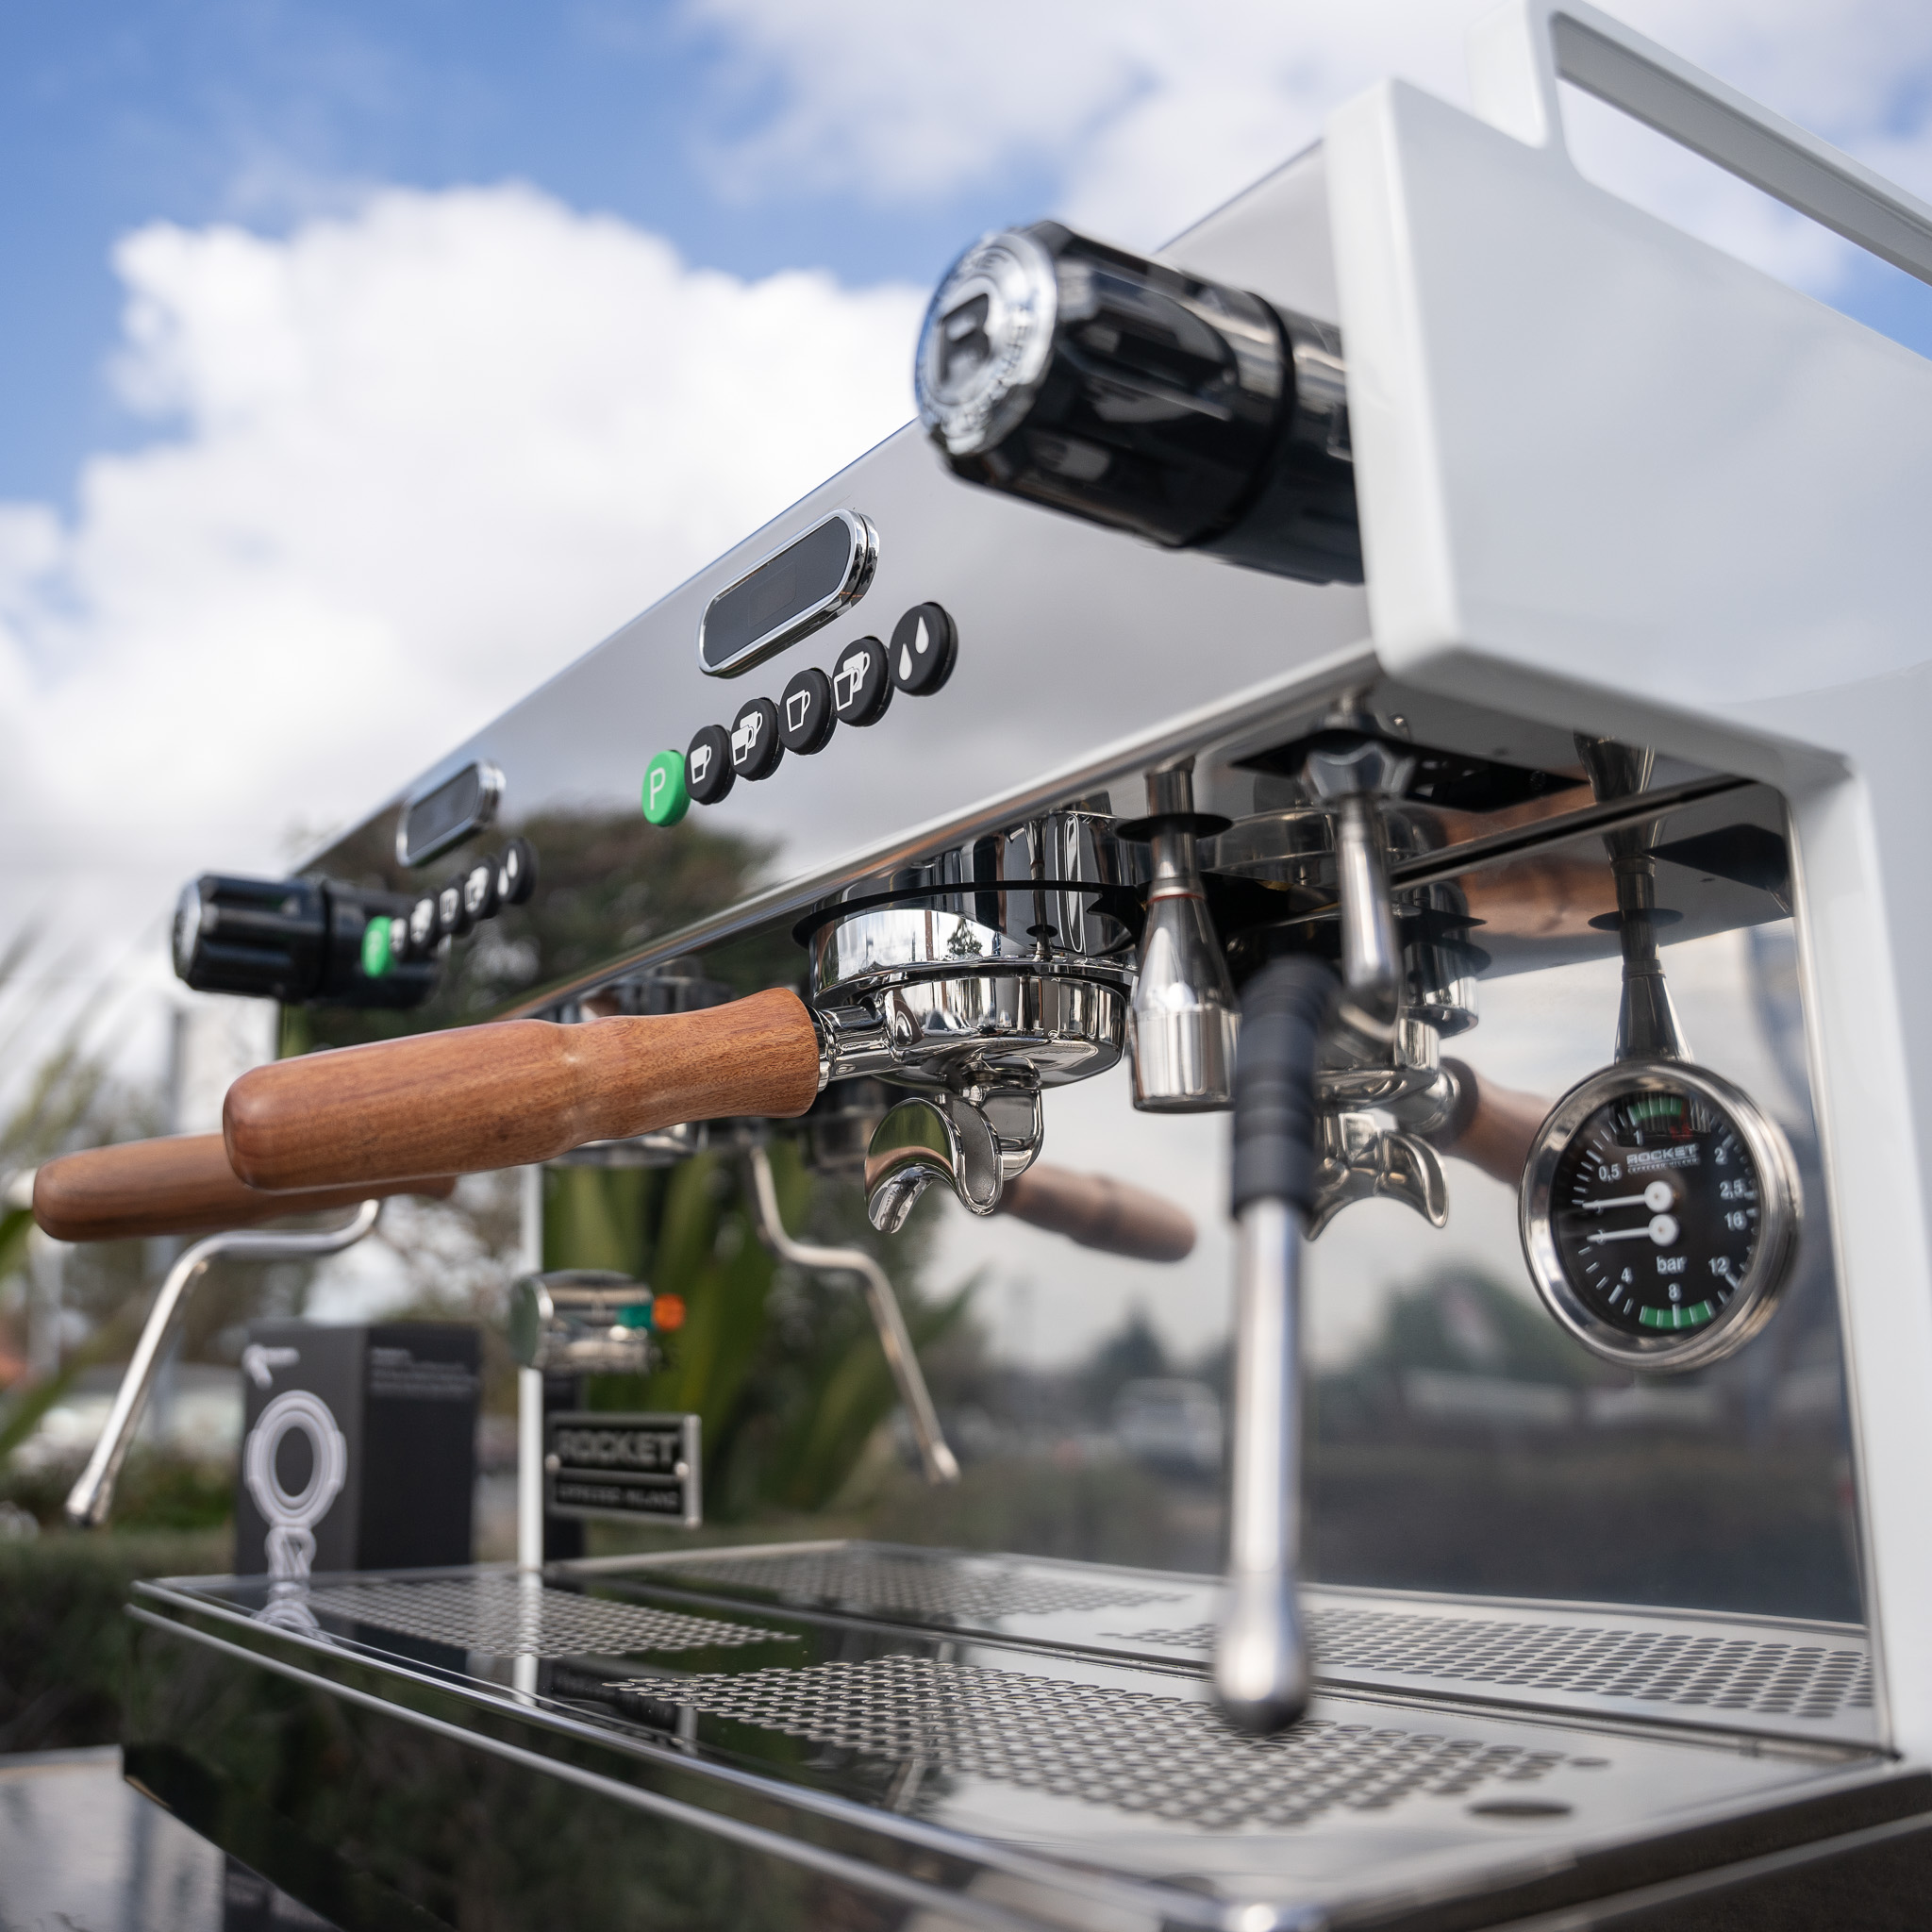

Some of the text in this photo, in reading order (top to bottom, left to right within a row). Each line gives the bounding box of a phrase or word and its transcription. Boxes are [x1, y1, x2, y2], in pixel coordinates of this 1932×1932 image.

[650, 767, 666, 810] P
[1633, 1130, 1642, 1146] 1
[1626, 1144, 1697, 1164] ROCKET
[1714, 1146, 1727, 1165] 2
[1598, 1163, 1621, 1182] 0,5
[1720, 1178, 1744, 1200] 2,5
[1724, 1210, 1746, 1230] 16
[1656, 1256, 1686, 1274] bar
[1708, 1256, 1729, 1275] 12
[1621, 1267, 1632, 1283] 4
[1669, 1283, 1681, 1301] 8
